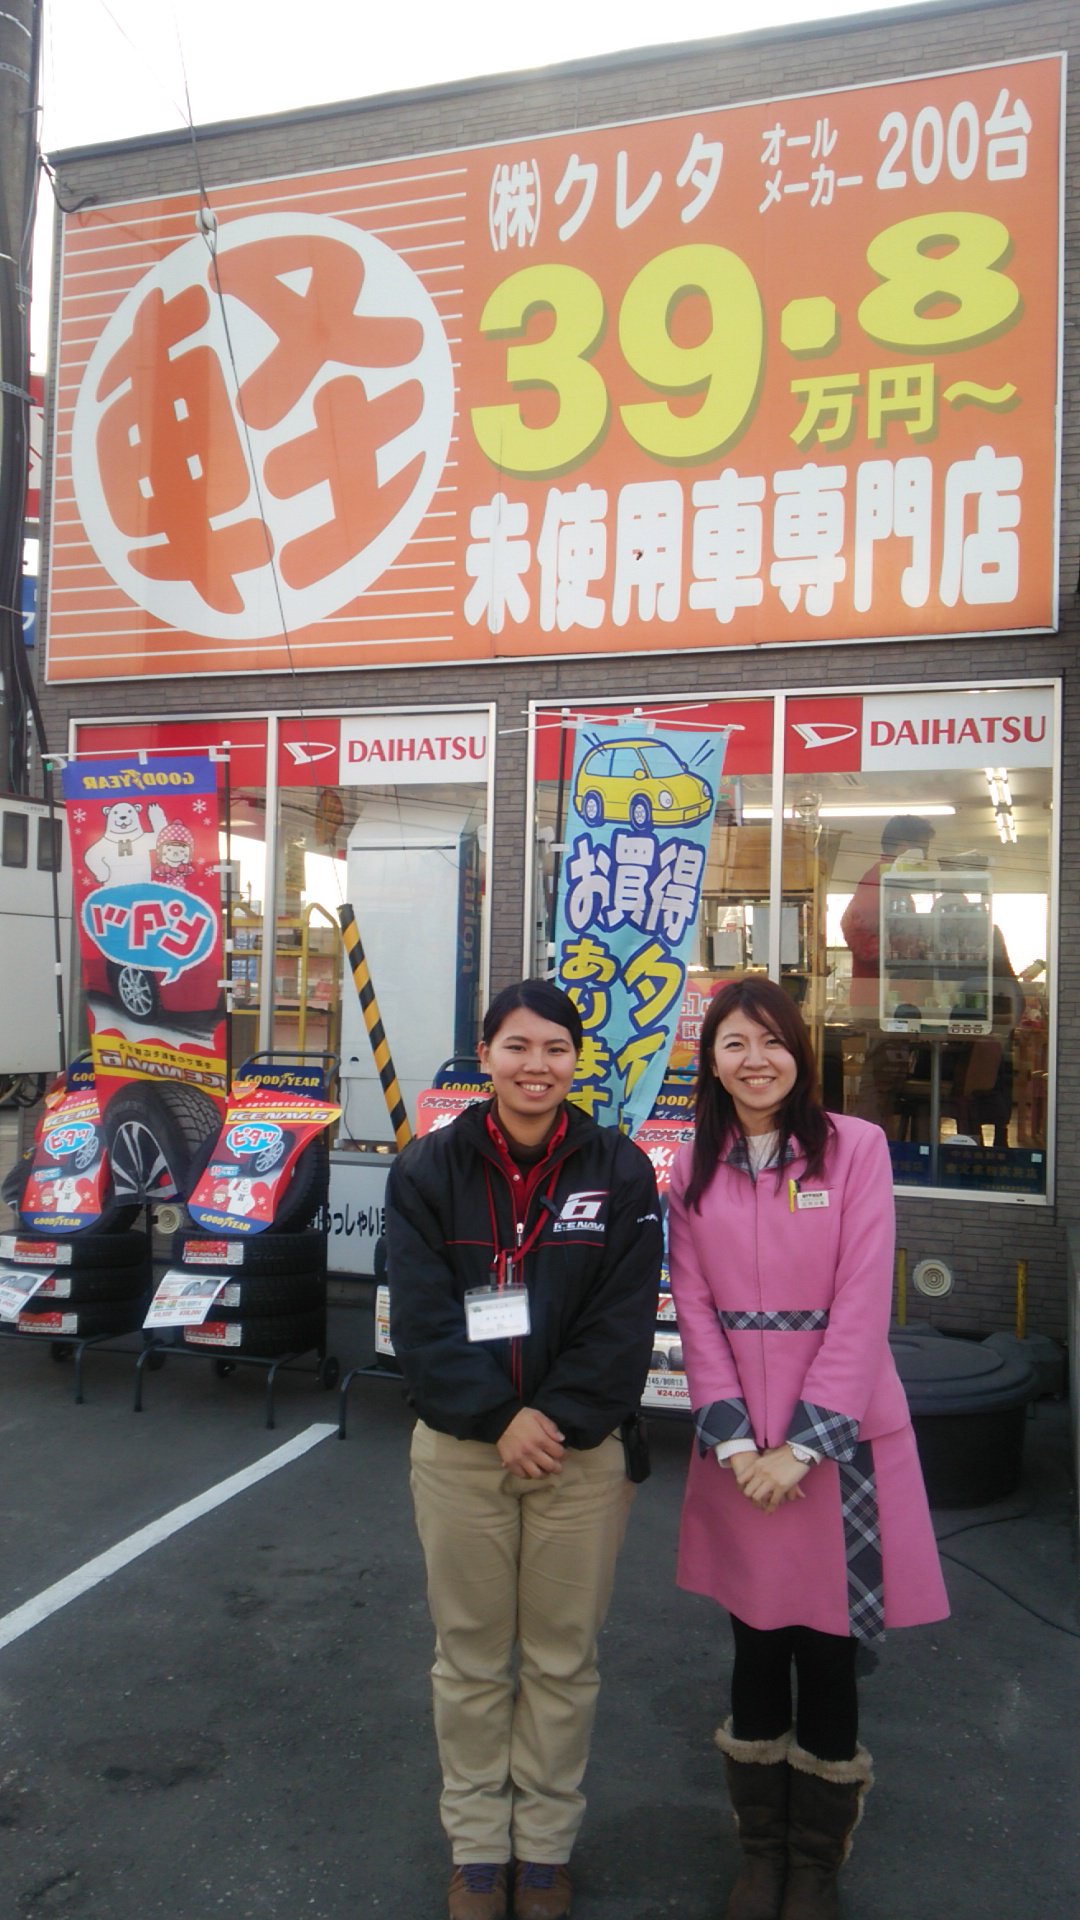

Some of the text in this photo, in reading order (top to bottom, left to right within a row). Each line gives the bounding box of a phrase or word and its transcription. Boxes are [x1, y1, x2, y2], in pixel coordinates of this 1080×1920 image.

[760, 117, 839, 165] オール
[876, 88, 1032, 190] 200台
[758, 163, 864, 214] メーカー
[96, 233, 427, 616] 軽
[464, 445, 1024, 633] 未使用車専門店
[347, 736, 487, 764] DAIHATSU
[869, 715, 1047, 747] DAIHATSU
[568, 834, 704, 943] お買得
[244, 1072, 320, 1087] GOODYEAR
[199, 1213, 252, 1232] GOODYEAR
[559, 1190, 610, 1220] 6
[576, 1221, 605, 1232] NAVI
